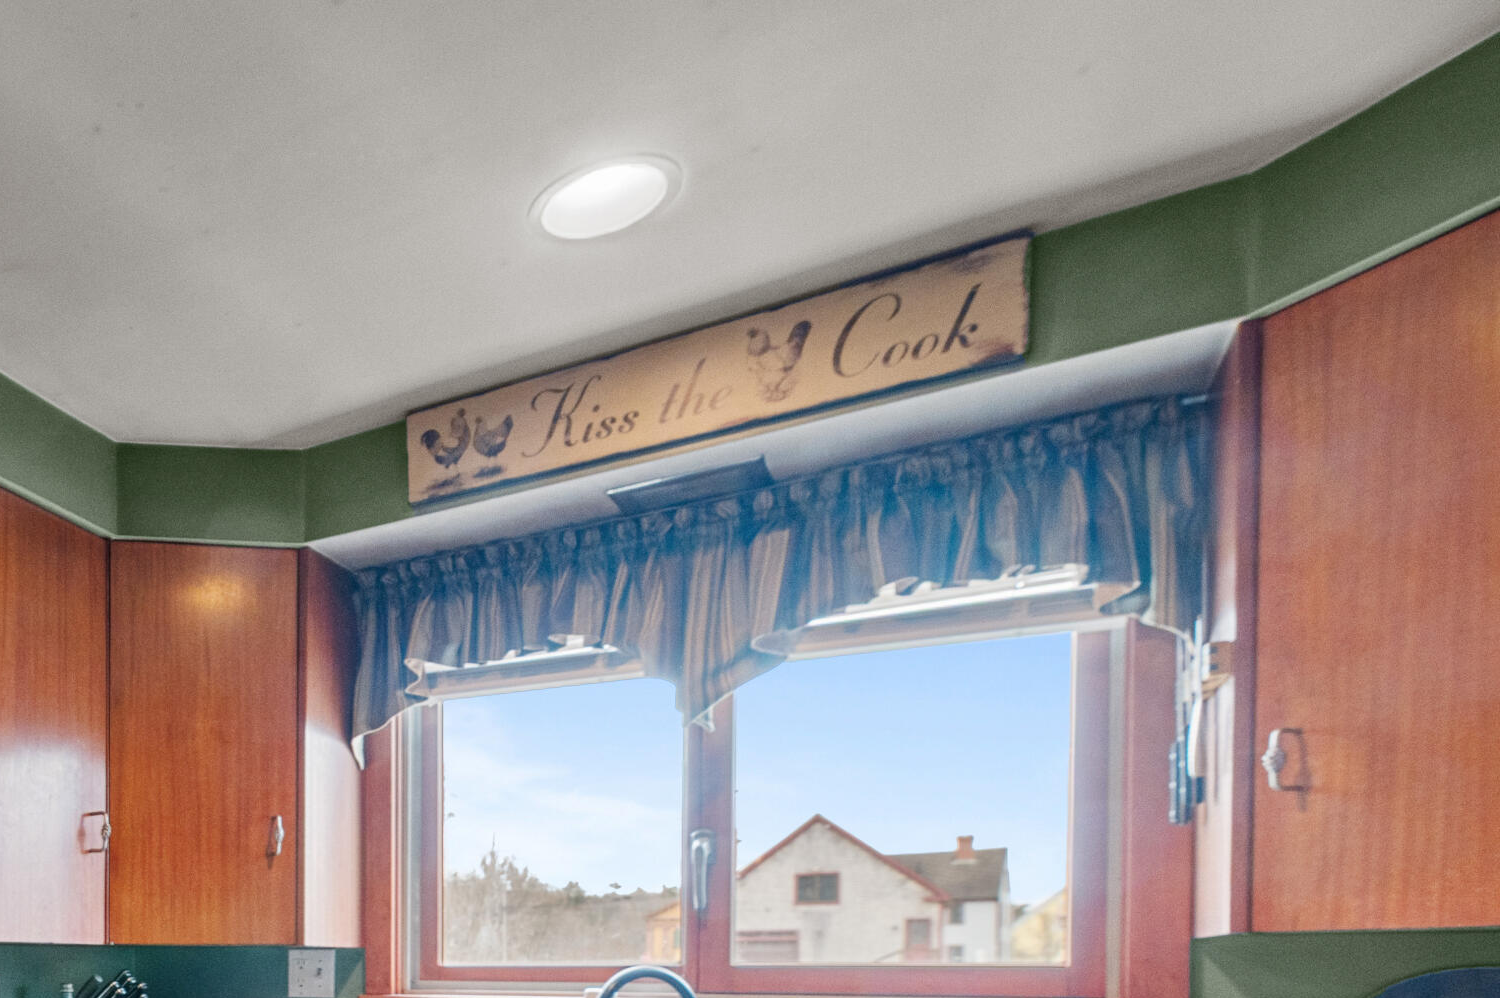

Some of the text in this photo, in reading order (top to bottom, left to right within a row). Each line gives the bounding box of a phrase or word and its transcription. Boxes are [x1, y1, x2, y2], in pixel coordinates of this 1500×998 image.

[522, 282, 983, 458] Kiss the Cook
